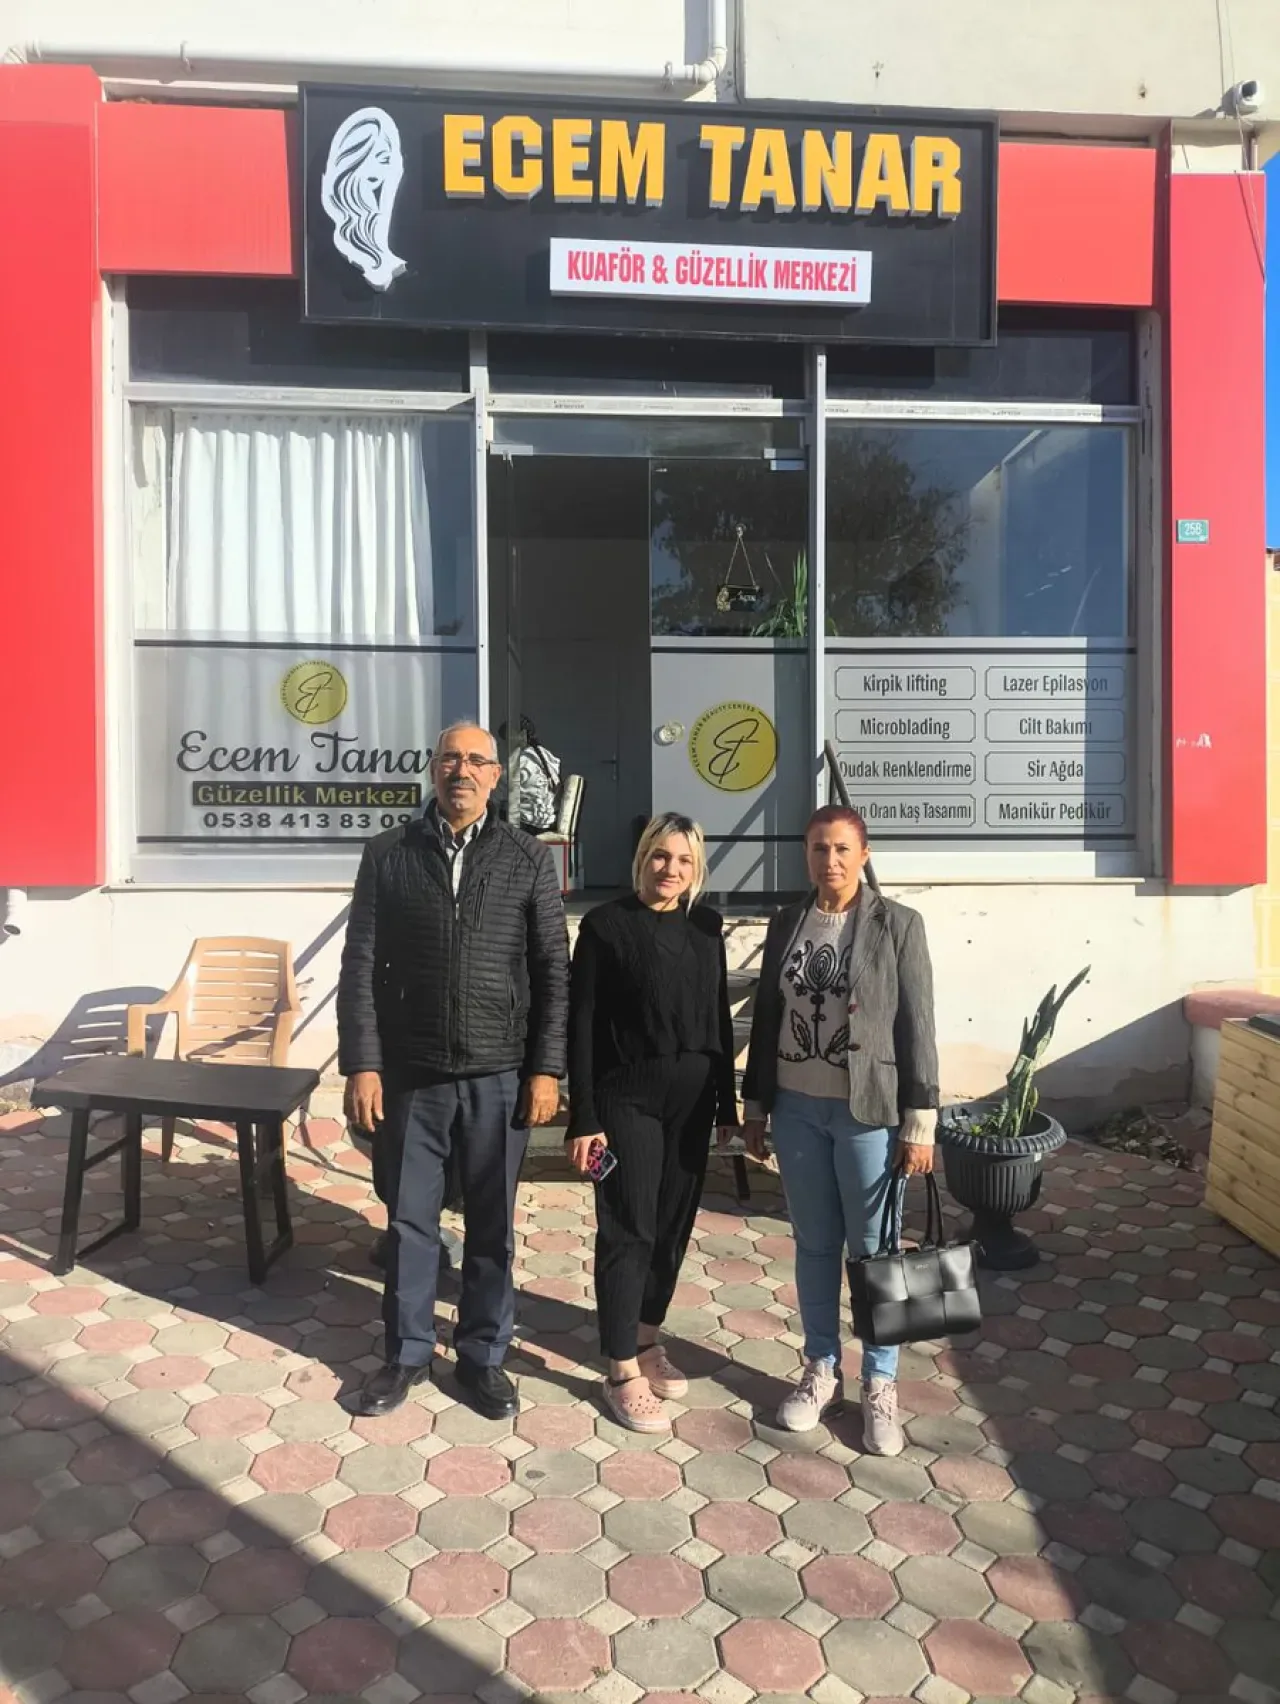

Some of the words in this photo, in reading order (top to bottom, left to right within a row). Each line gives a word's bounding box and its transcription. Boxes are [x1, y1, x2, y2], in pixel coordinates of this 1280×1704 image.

[444, 114, 666, 206] ECEM
[700, 124, 961, 218] TANAR
[567, 247, 645, 284] KUAFÖR
[652, 254, 669, 285] &
[675, 250, 769, 288] GÜZELLİK
[774, 256, 857, 292] MERKEZİ
[863, 674, 903, 696] Kirpik
[906, 674, 947, 696] lifting
[1003, 675, 1040, 692] Lazer
[1043, 674, 1108, 696] Epilasyon
[860, 717, 951, 739] Microblading
[1019, 717, 1042, 735] Cilt
[1046, 717, 1092, 735] Bakımı
[176, 730, 300, 773] Ecem
[883, 759, 972, 778] Renklendirme
[1027, 759, 1046, 777] Sir
[1050, 759, 1084, 781] Ağda
[197, 784, 306, 805] Güzellik
[316, 786, 417, 805] Merkezi
[203, 812, 271, 829] 0538
[280, 812, 330, 829] 413
[340, 813, 371, 829] 83
[870, 802, 897, 819] Oran
[900, 802, 920, 823] Kaş
[999, 801, 1056, 819] Manikür
[1059, 801, 1112, 820] Pedikür
